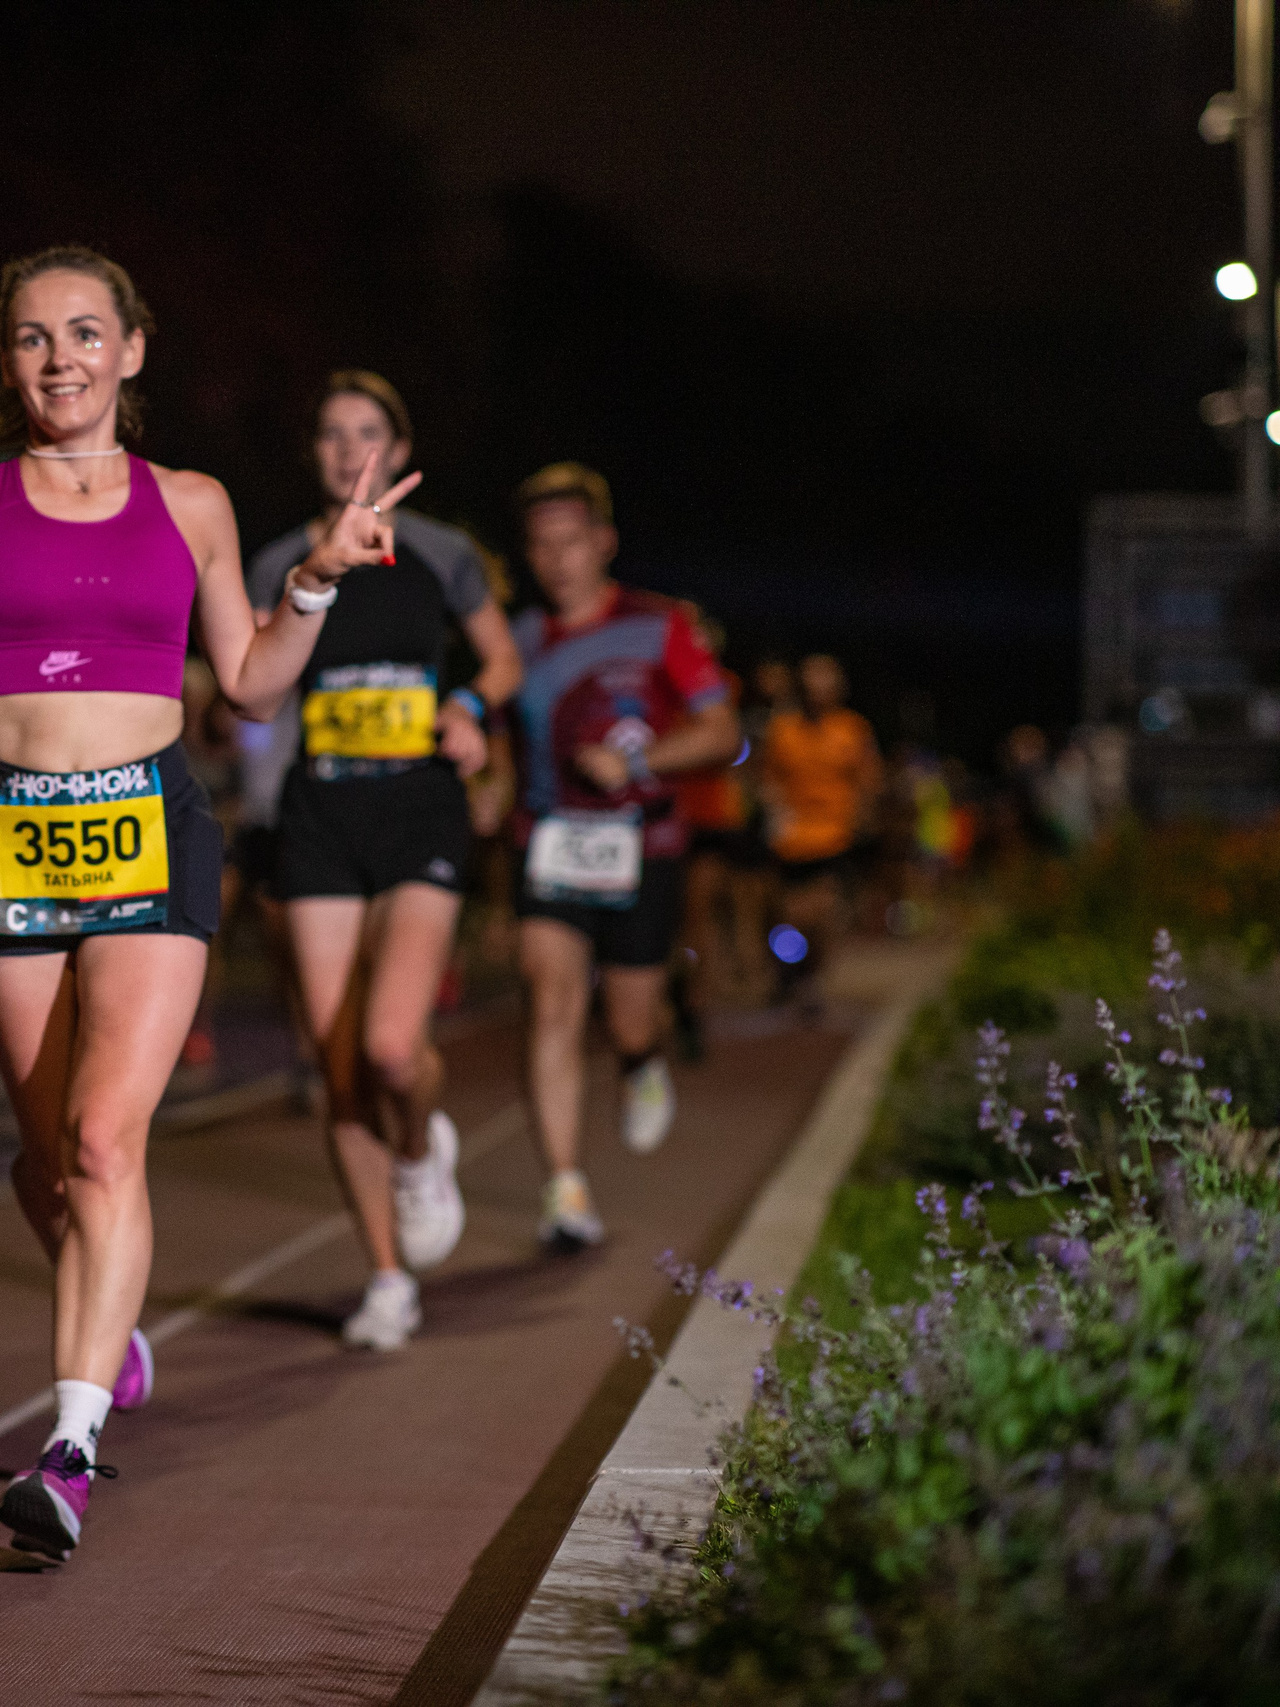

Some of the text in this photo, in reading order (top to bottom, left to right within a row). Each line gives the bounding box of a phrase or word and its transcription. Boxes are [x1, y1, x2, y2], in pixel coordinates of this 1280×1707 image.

[13, 815, 142, 868] 3550
[43, 871, 115, 888] ТАТЬЯНА
[6, 902, 28, 932] C
